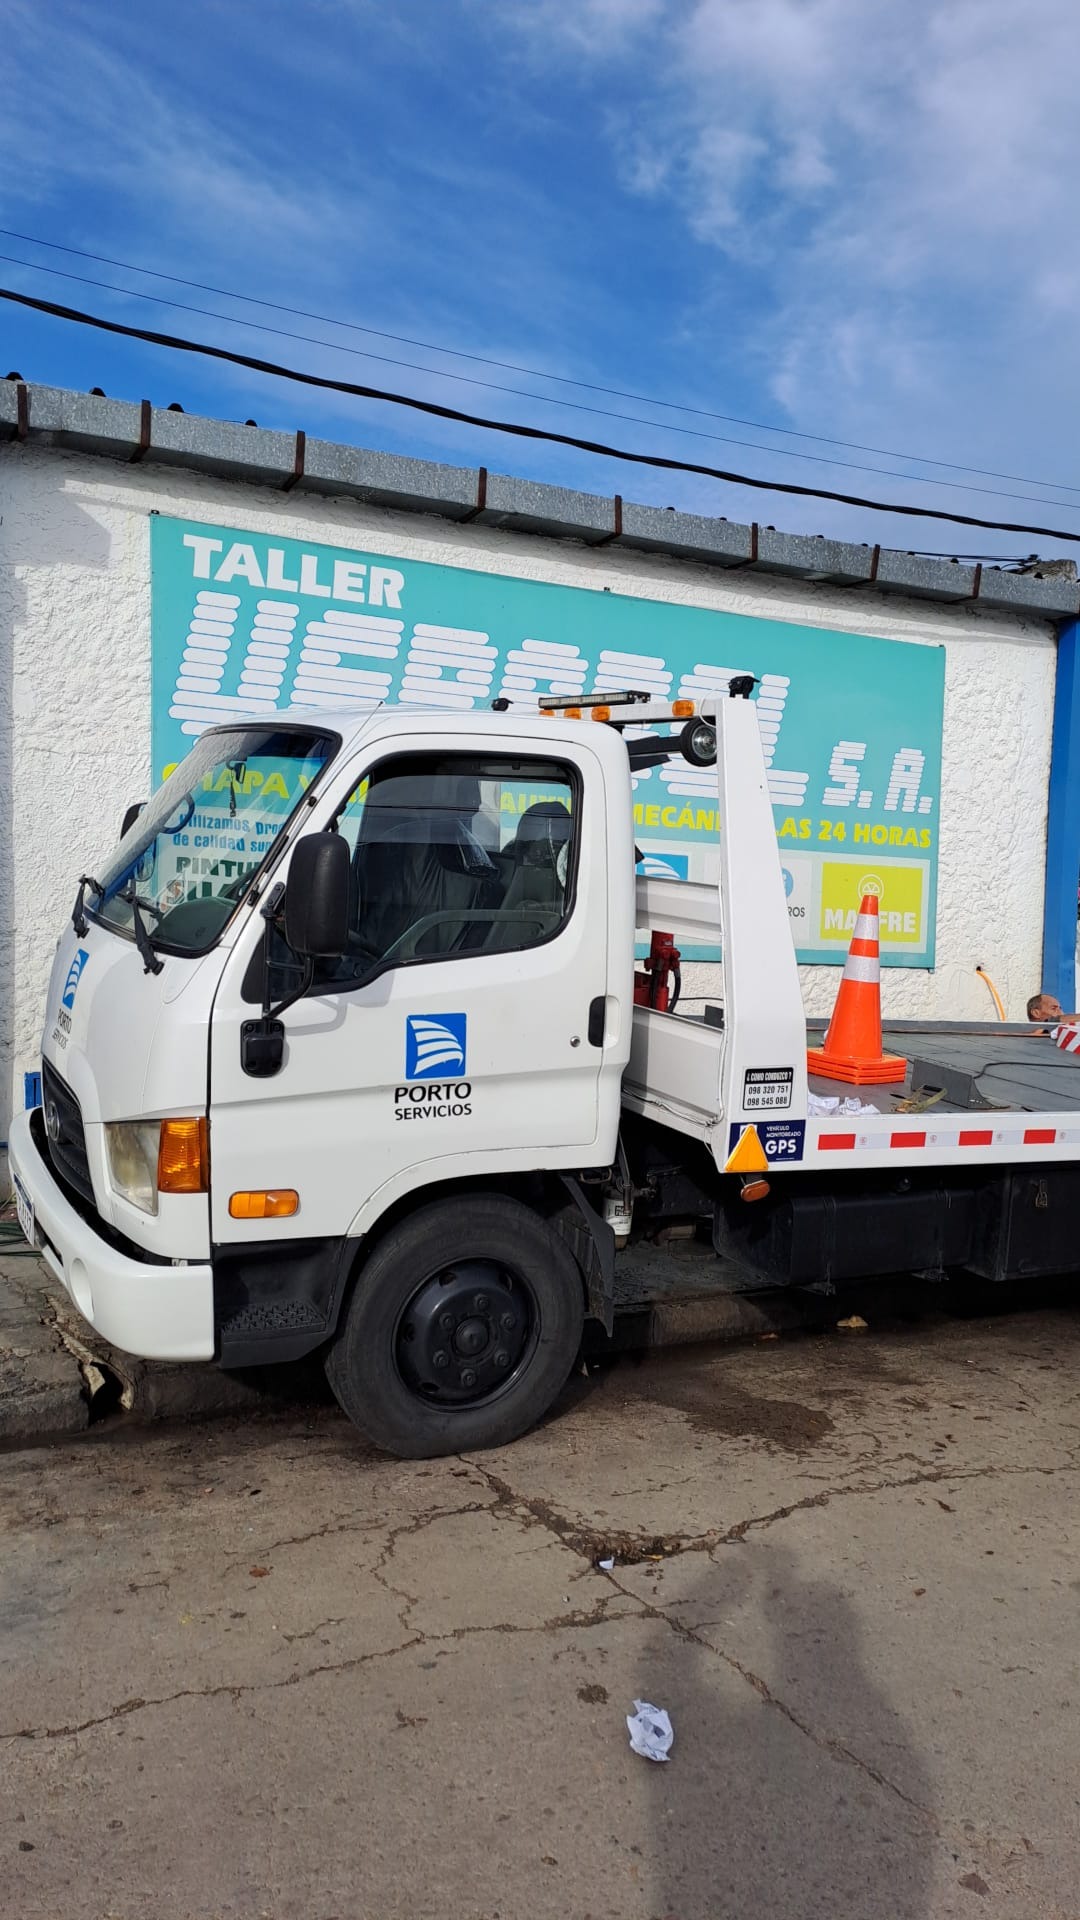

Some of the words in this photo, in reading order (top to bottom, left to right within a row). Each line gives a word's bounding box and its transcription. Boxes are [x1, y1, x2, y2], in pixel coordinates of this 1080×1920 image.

[182, 534, 405, 608] TALLER
[173, 833, 189, 846] de
[194, 834, 245, 851] calidad
[818, 820, 846, 842] 24
[853, 823, 931, 848] HORAS
[824, 909, 916, 933] MAFRE
[394, 1082, 472, 1104] PORTO
[748, 1086, 761, 1095] 098
[762, 1085, 775, 1094] 320
[777, 1085, 789, 1094] 751
[746, 1098, 760, 1106] 098
[761, 1097, 774, 1106] 545
[394, 1103, 472, 1121] SERVICIOS
[765, 1139, 796, 1154] GPS
